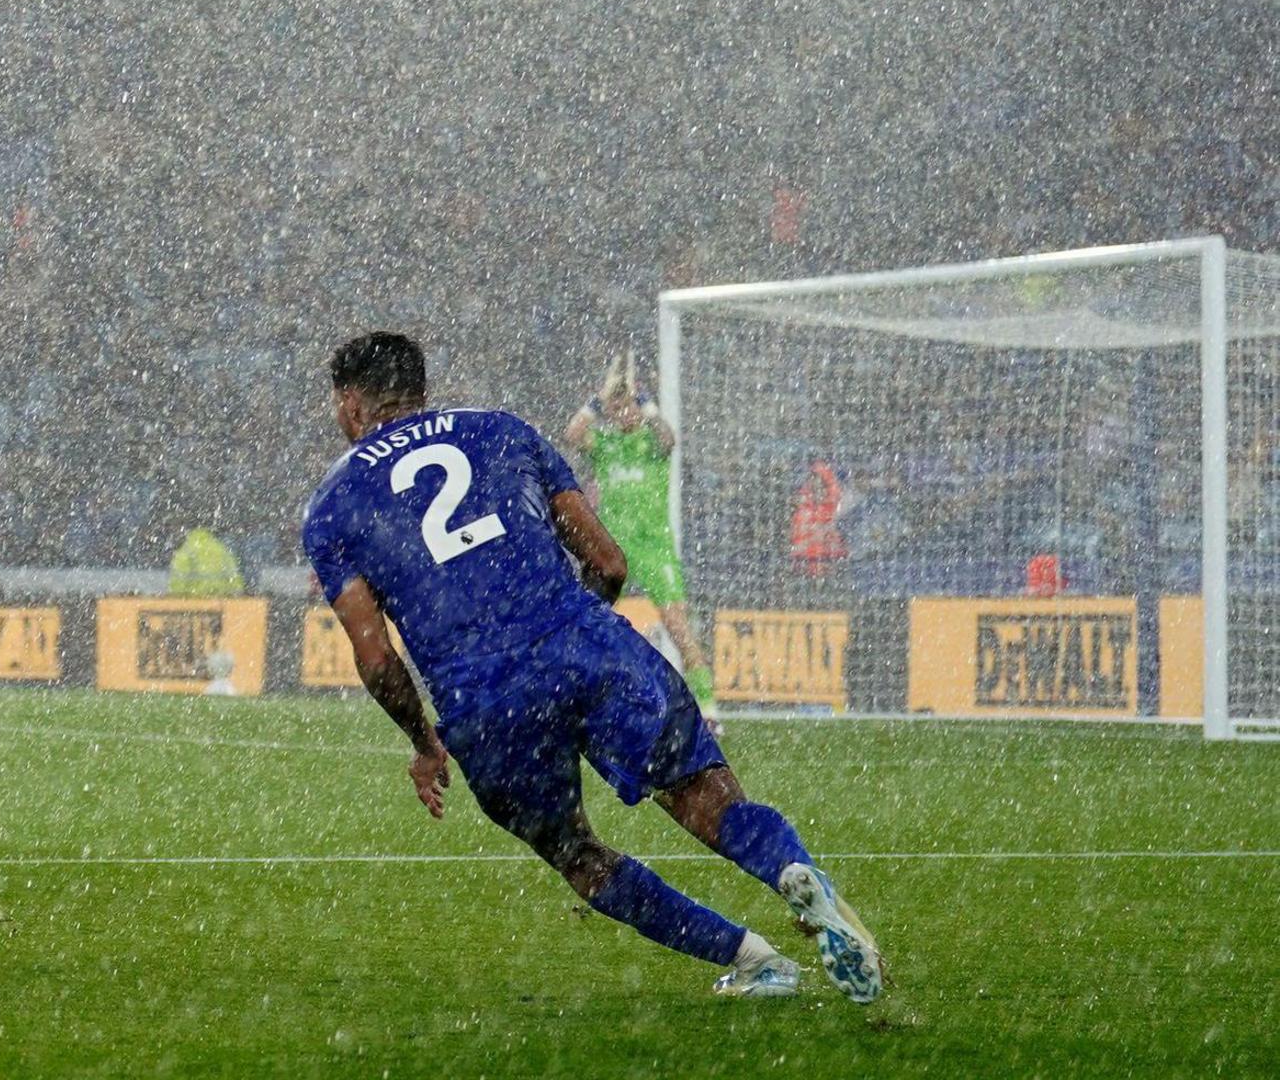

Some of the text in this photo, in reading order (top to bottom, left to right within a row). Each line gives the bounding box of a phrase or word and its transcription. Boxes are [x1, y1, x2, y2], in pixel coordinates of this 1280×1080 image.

[357, 414, 455, 467] JUSTIN
[391, 443, 507, 565] 2
[975, 613, 1133, 707] DEWALT
